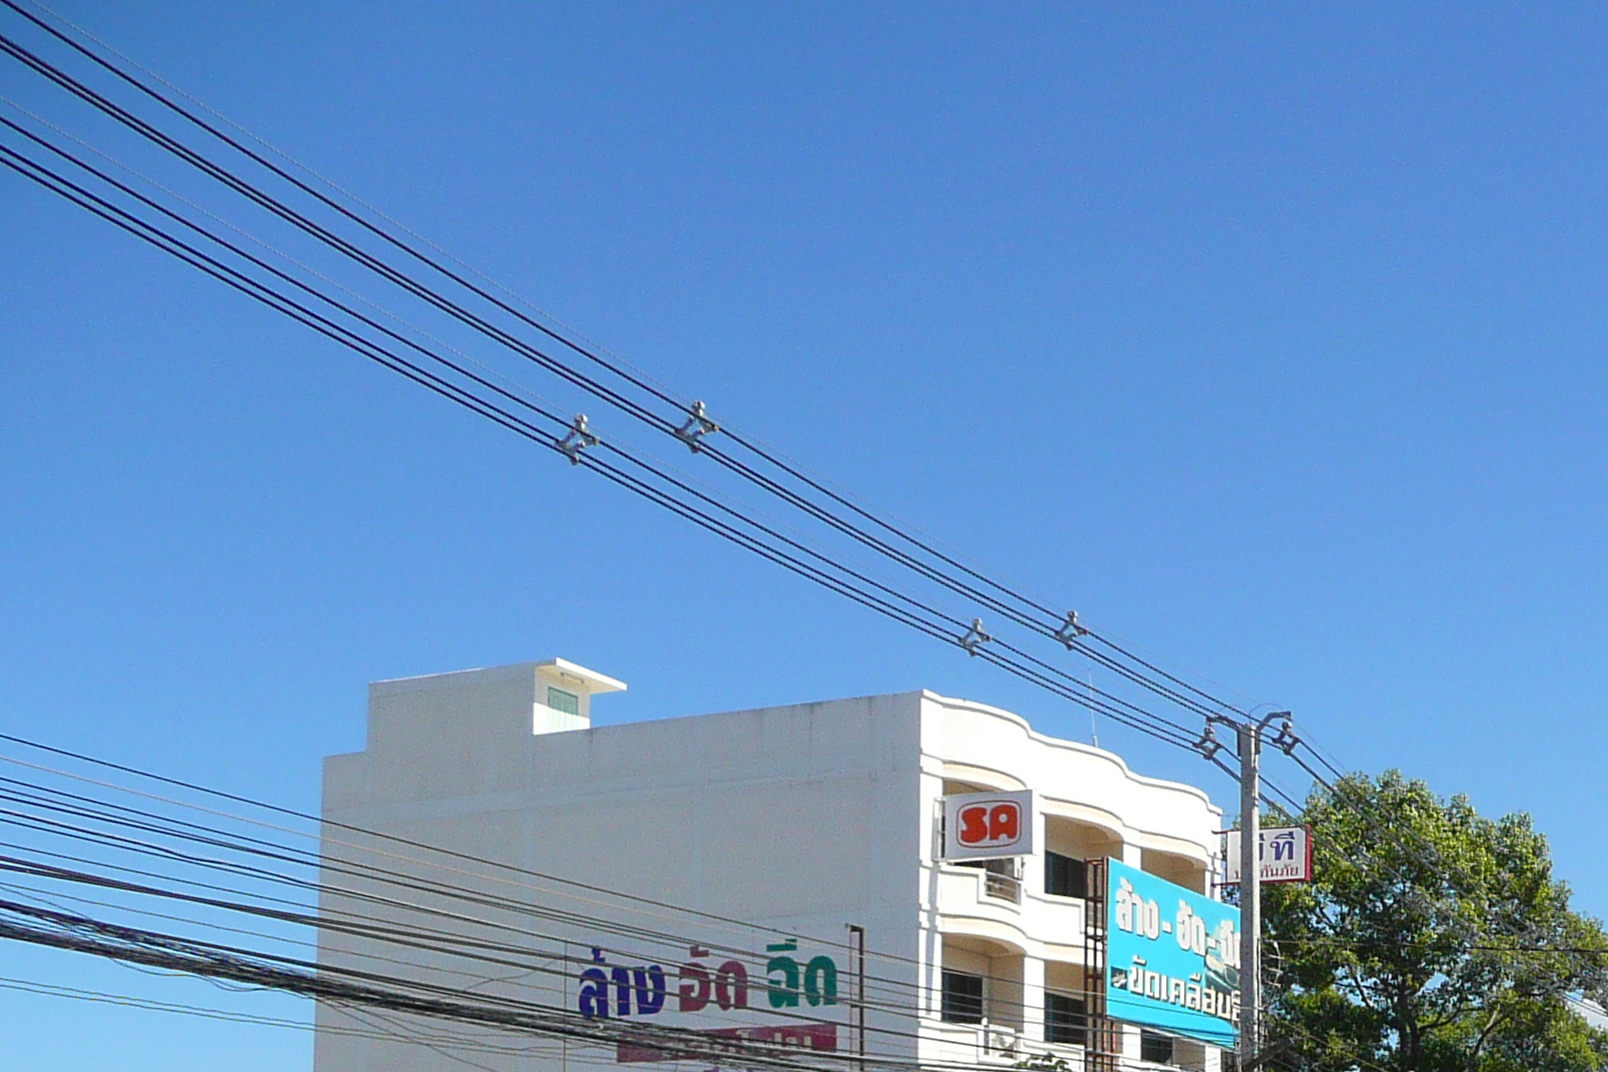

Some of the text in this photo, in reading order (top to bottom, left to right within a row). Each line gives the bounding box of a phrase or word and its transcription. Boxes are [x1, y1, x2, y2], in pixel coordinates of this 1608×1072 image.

[960, 803, 1018, 844] SA
[578, 938, 838, 1018] ล้าง อัด ฉีด
